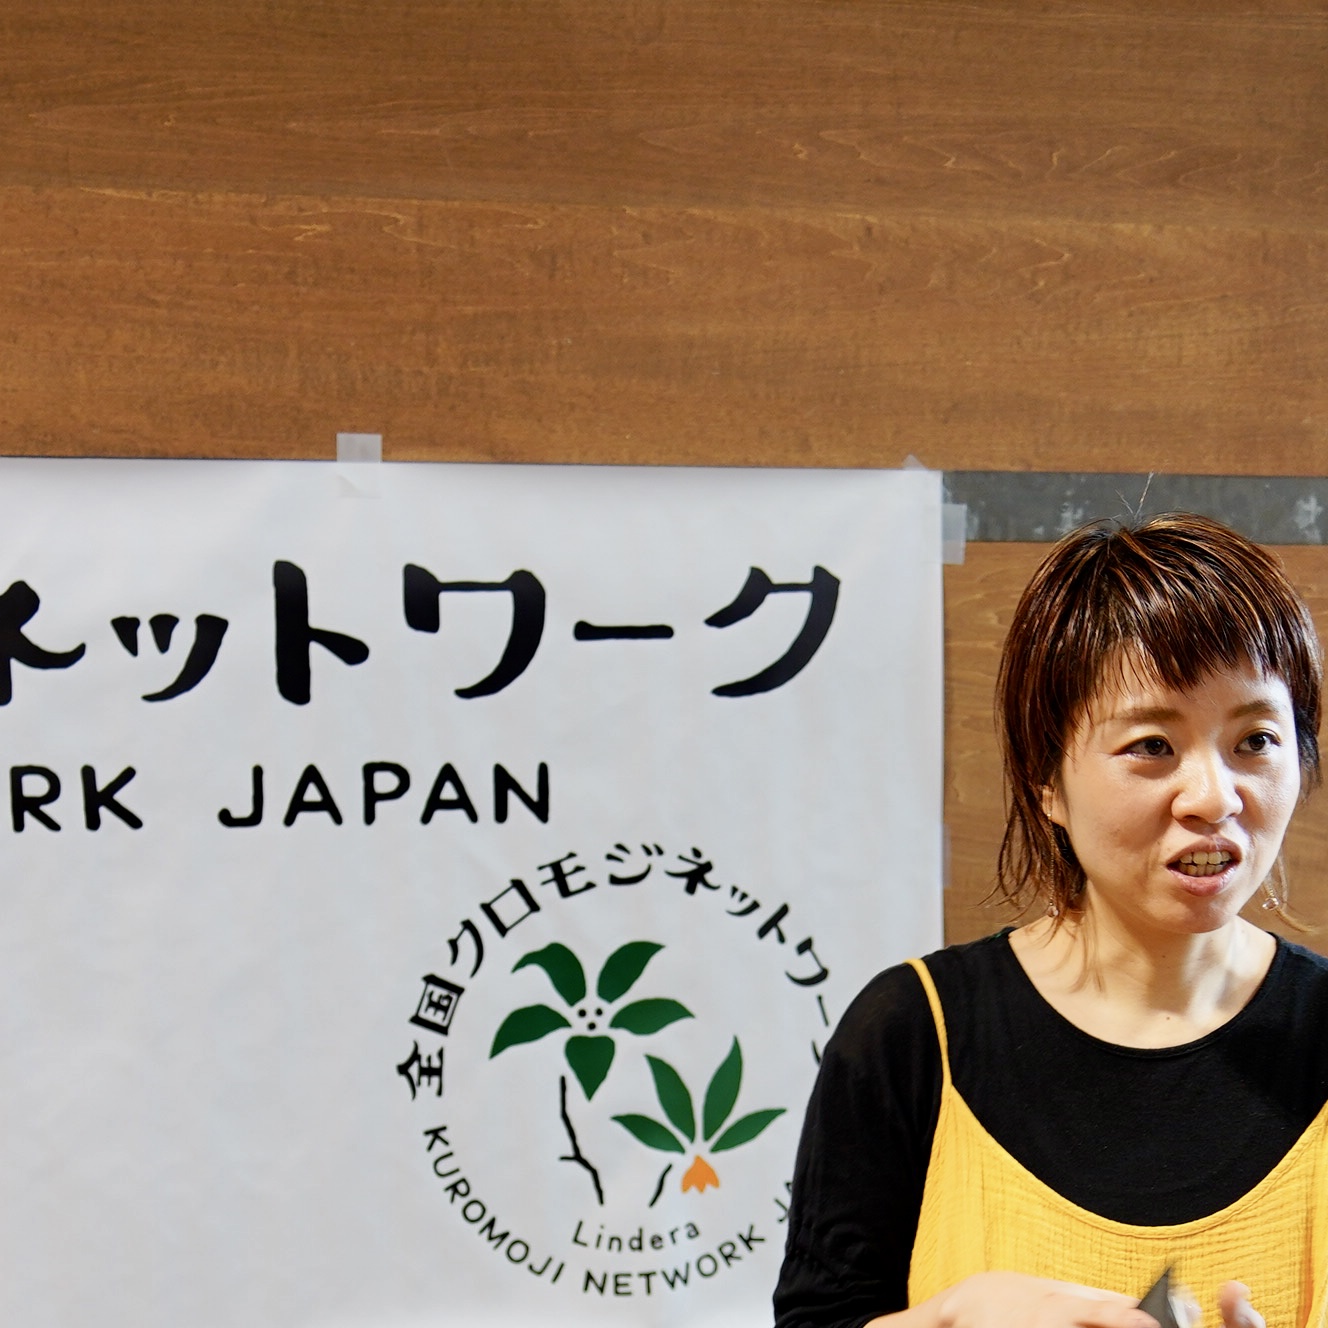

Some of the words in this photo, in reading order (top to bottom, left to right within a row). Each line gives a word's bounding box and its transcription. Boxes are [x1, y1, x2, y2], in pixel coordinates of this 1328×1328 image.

[218, 762, 549, 828] JAPAN
[397, 843, 830, 1098] 全国クロモジネットワー
[424, 1126, 565, 1284] KUROMOJI
[583, 1224, 765, 1296] NETWORK
[573, 1220, 700, 1253] Lindera
